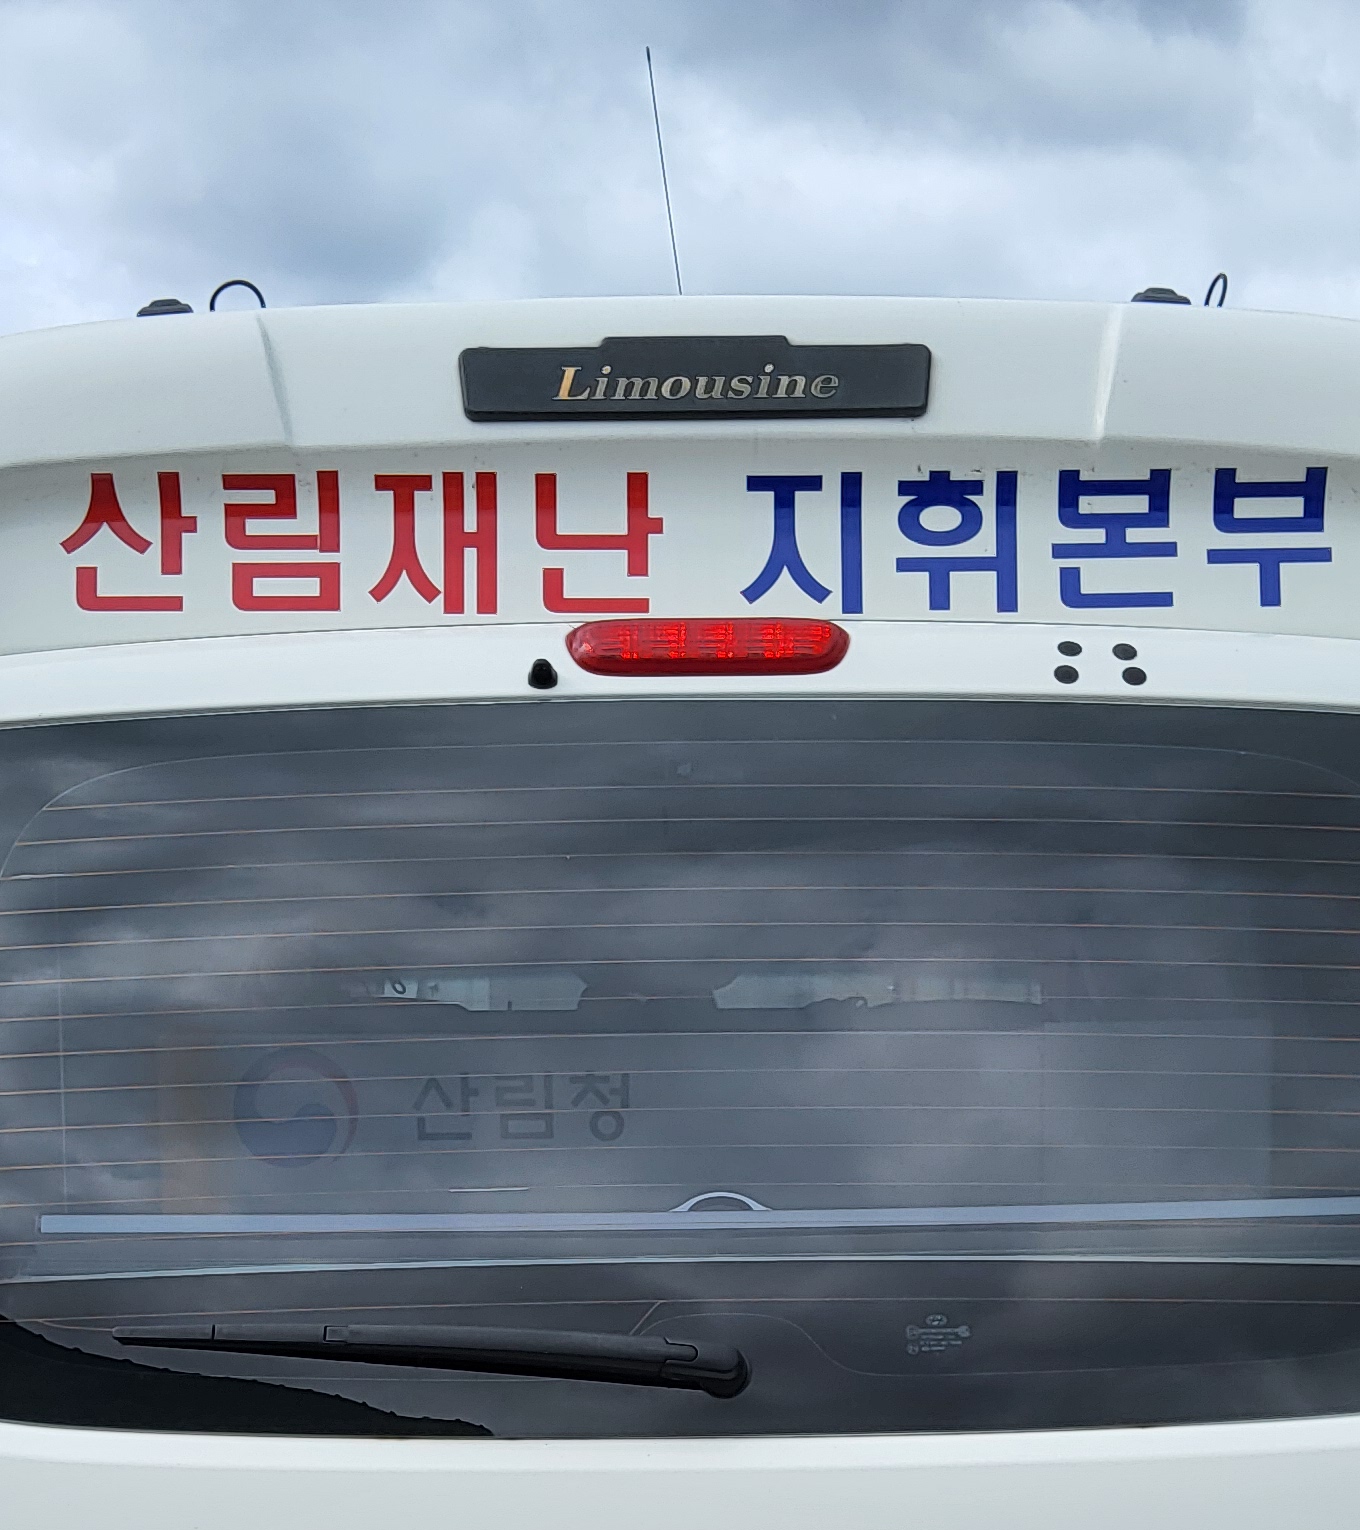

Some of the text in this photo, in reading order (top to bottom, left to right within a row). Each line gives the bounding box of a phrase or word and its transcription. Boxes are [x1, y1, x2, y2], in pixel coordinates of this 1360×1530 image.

[551, 363, 840, 401] Limousine
[59, 469, 1333, 616] 산림재난 지휘본부
[411, 1070, 631, 1142] 산림청
